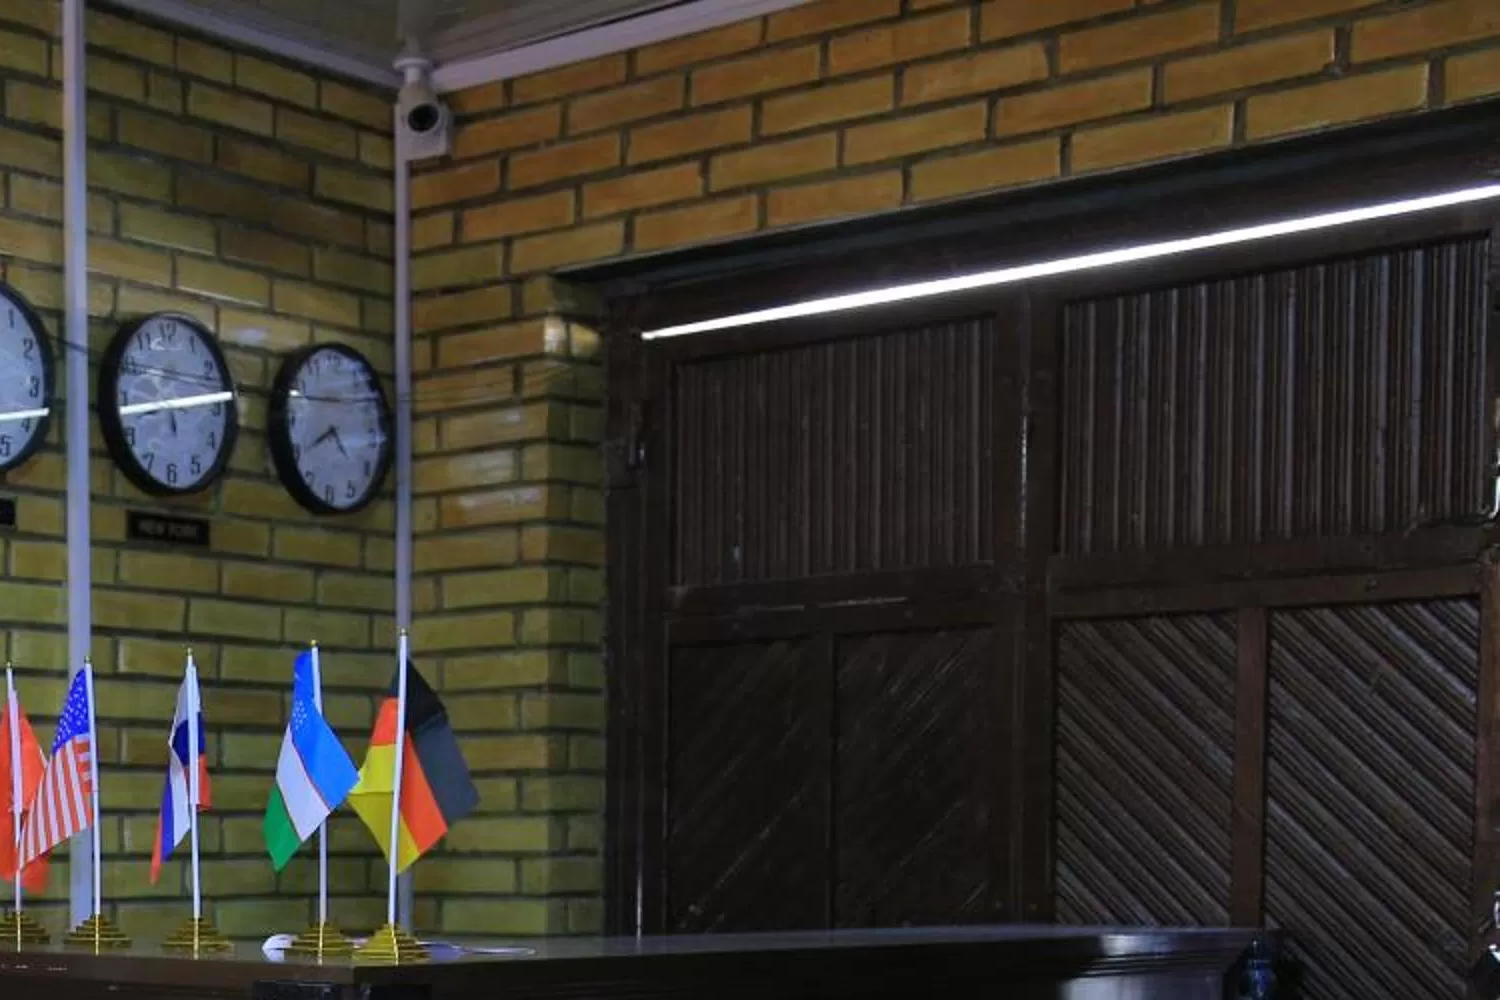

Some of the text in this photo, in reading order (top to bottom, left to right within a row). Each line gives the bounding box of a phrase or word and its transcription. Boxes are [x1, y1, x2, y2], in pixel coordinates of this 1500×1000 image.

[8, 308, 15, 329] 1
[23, 337, 34, 359] 2
[29, 375, 40, 398] 3
[190, 454, 201, 475] 5
